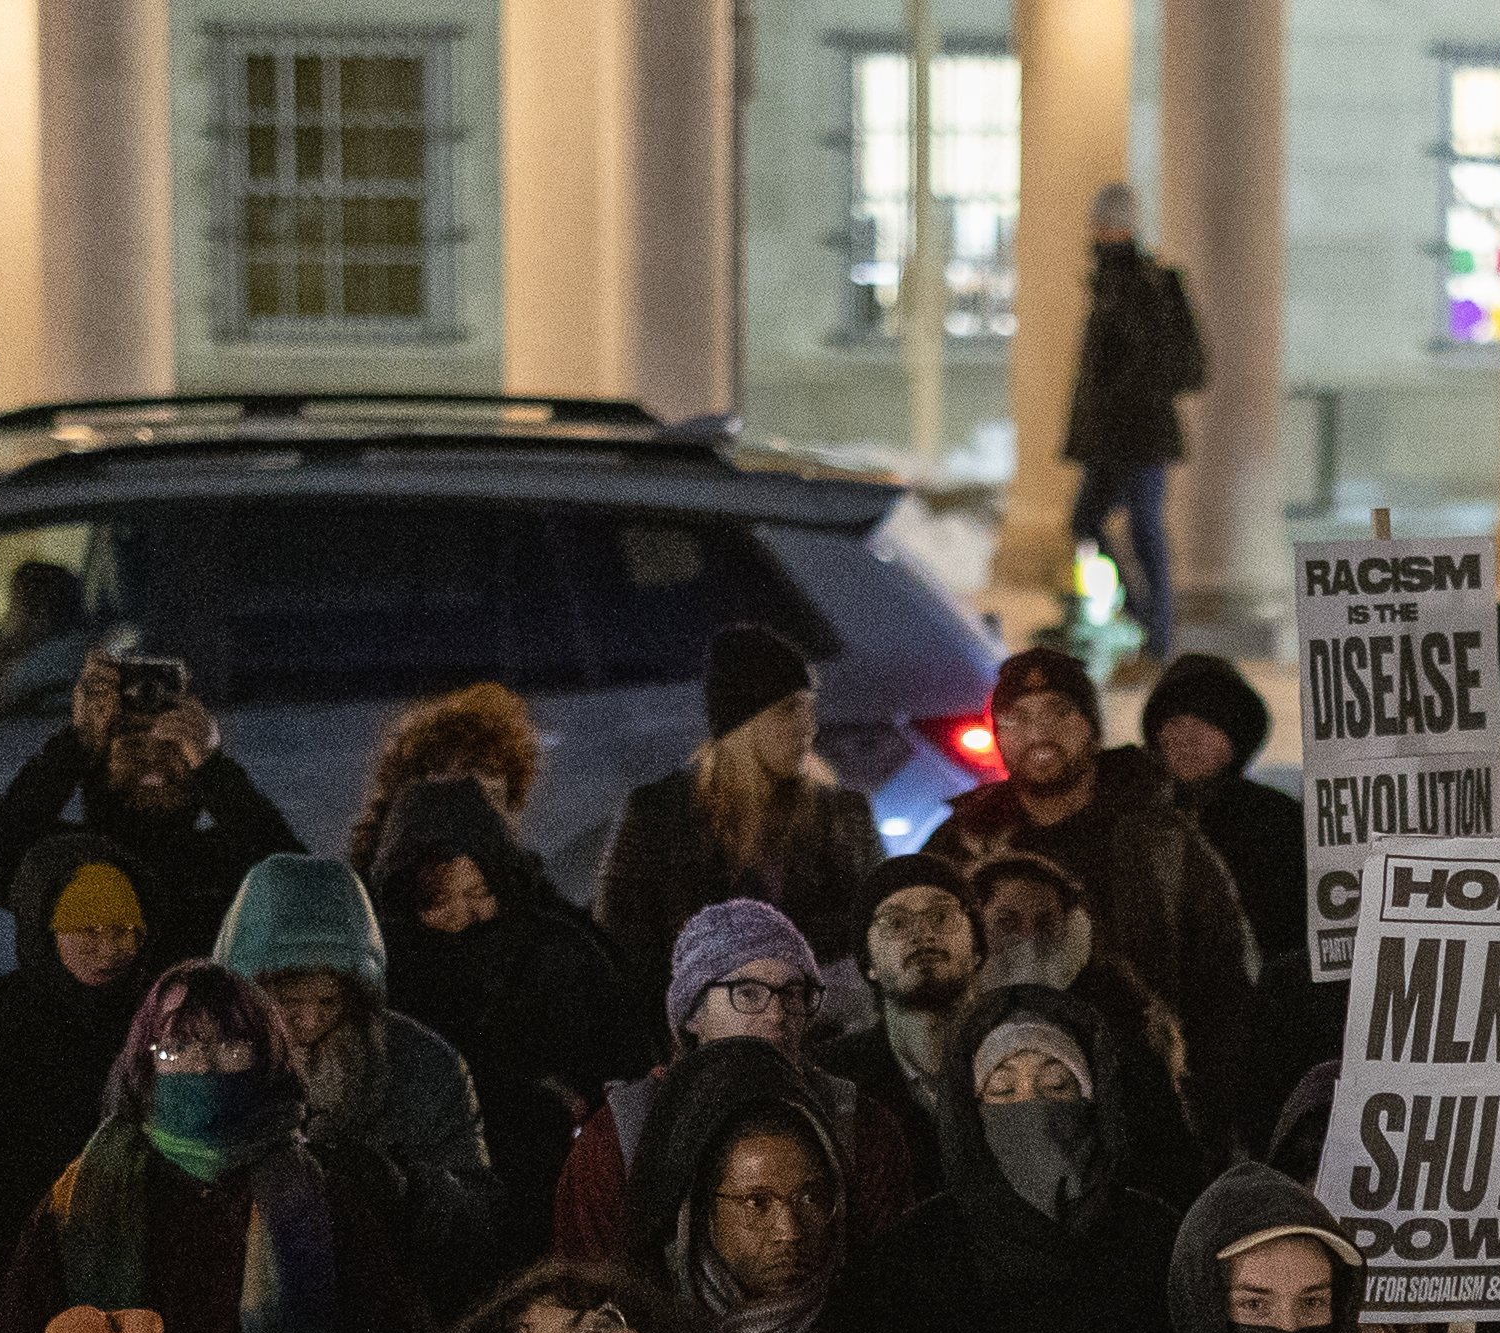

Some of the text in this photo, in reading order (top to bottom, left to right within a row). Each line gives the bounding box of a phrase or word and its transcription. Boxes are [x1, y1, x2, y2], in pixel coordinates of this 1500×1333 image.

[1305, 554, 1482, 596] RACISM
[1348, 602, 1419, 625] IS THE
[1309, 631, 1487, 741] DISEASE
[1315, 766, 1493, 847] REVOLUTION
[1376, 1275, 1407, 1301] FOR
[1407, 1274, 1484, 1302] SOCIALISM
